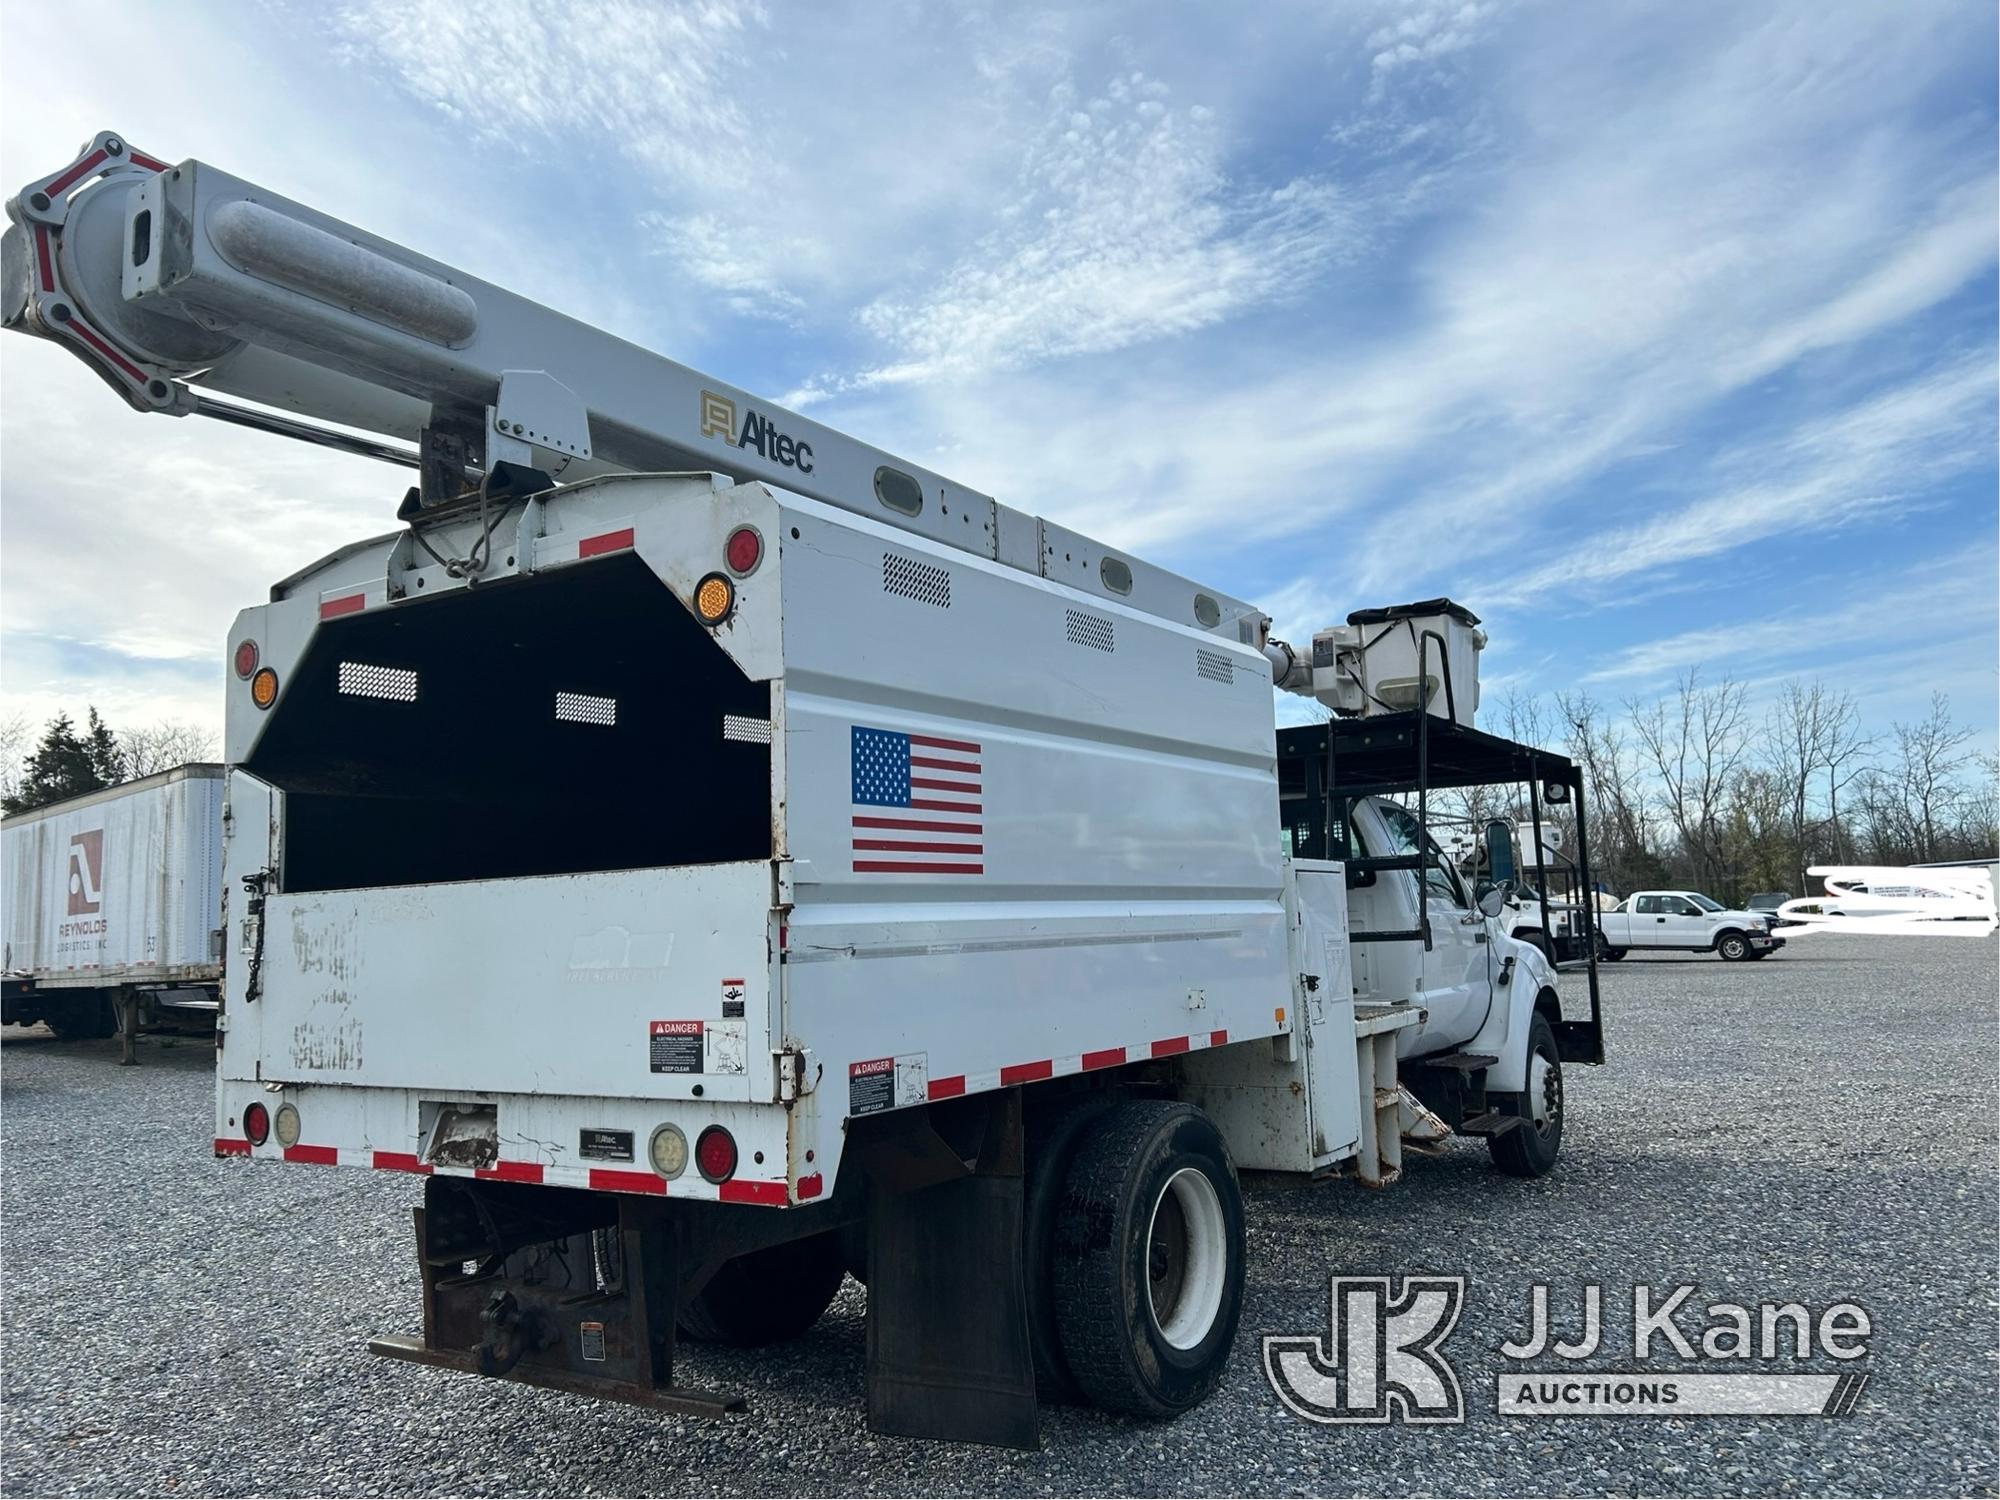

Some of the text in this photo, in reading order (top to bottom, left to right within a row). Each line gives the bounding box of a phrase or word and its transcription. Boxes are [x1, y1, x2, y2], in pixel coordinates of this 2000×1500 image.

[738, 409, 813, 474] Altec
[59, 919, 107, 937] REYNOLDS
[664, 1023, 698, 1034] DANGER
[862, 1060, 890, 1074] DANGER
